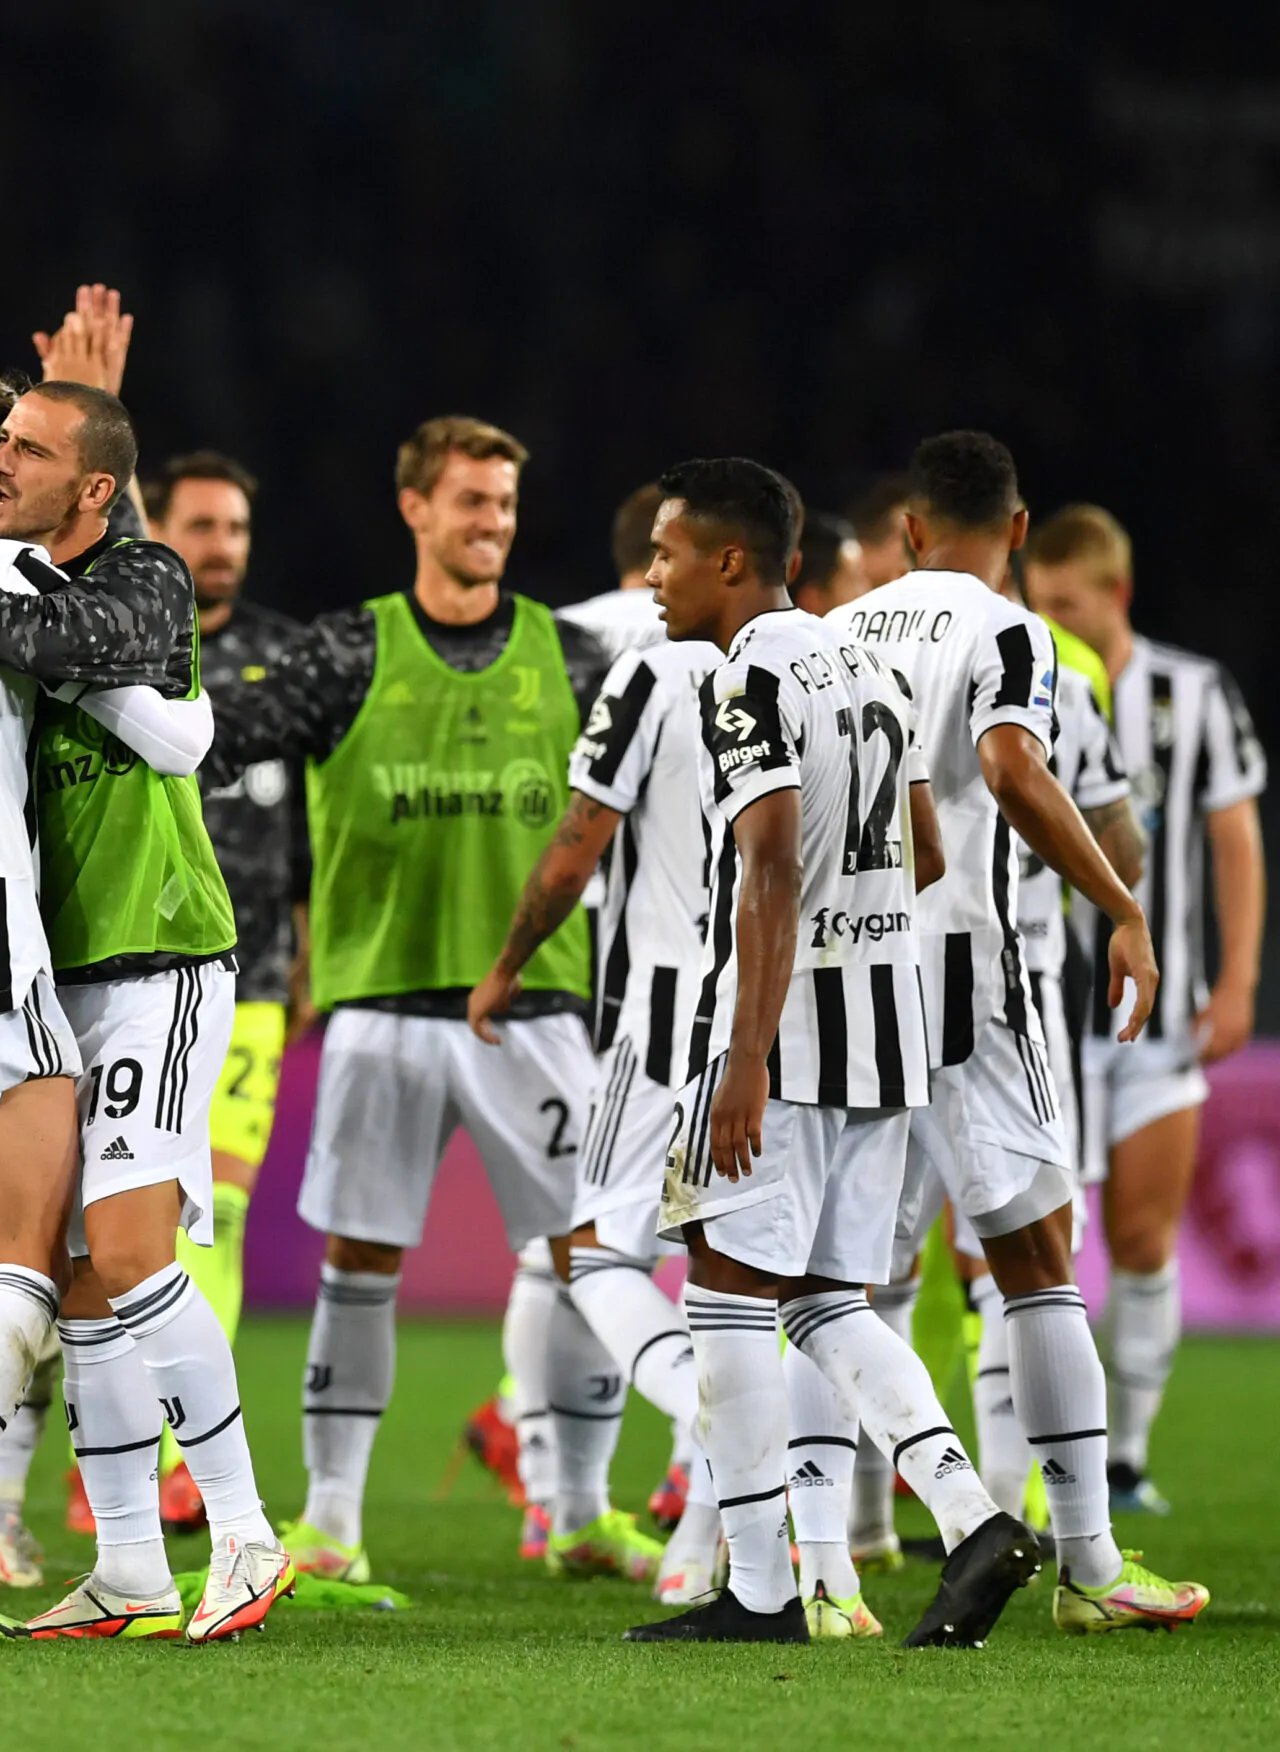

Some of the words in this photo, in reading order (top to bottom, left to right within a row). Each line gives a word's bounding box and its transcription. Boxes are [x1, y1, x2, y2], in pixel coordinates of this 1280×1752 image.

[719, 740, 771, 772] Bitget
[835, 700, 903, 876] 12
[87, 1057, 143, 1127] 19
[101, 1149, 135, 1160] adidas
[935, 1461, 972, 1479] adida
